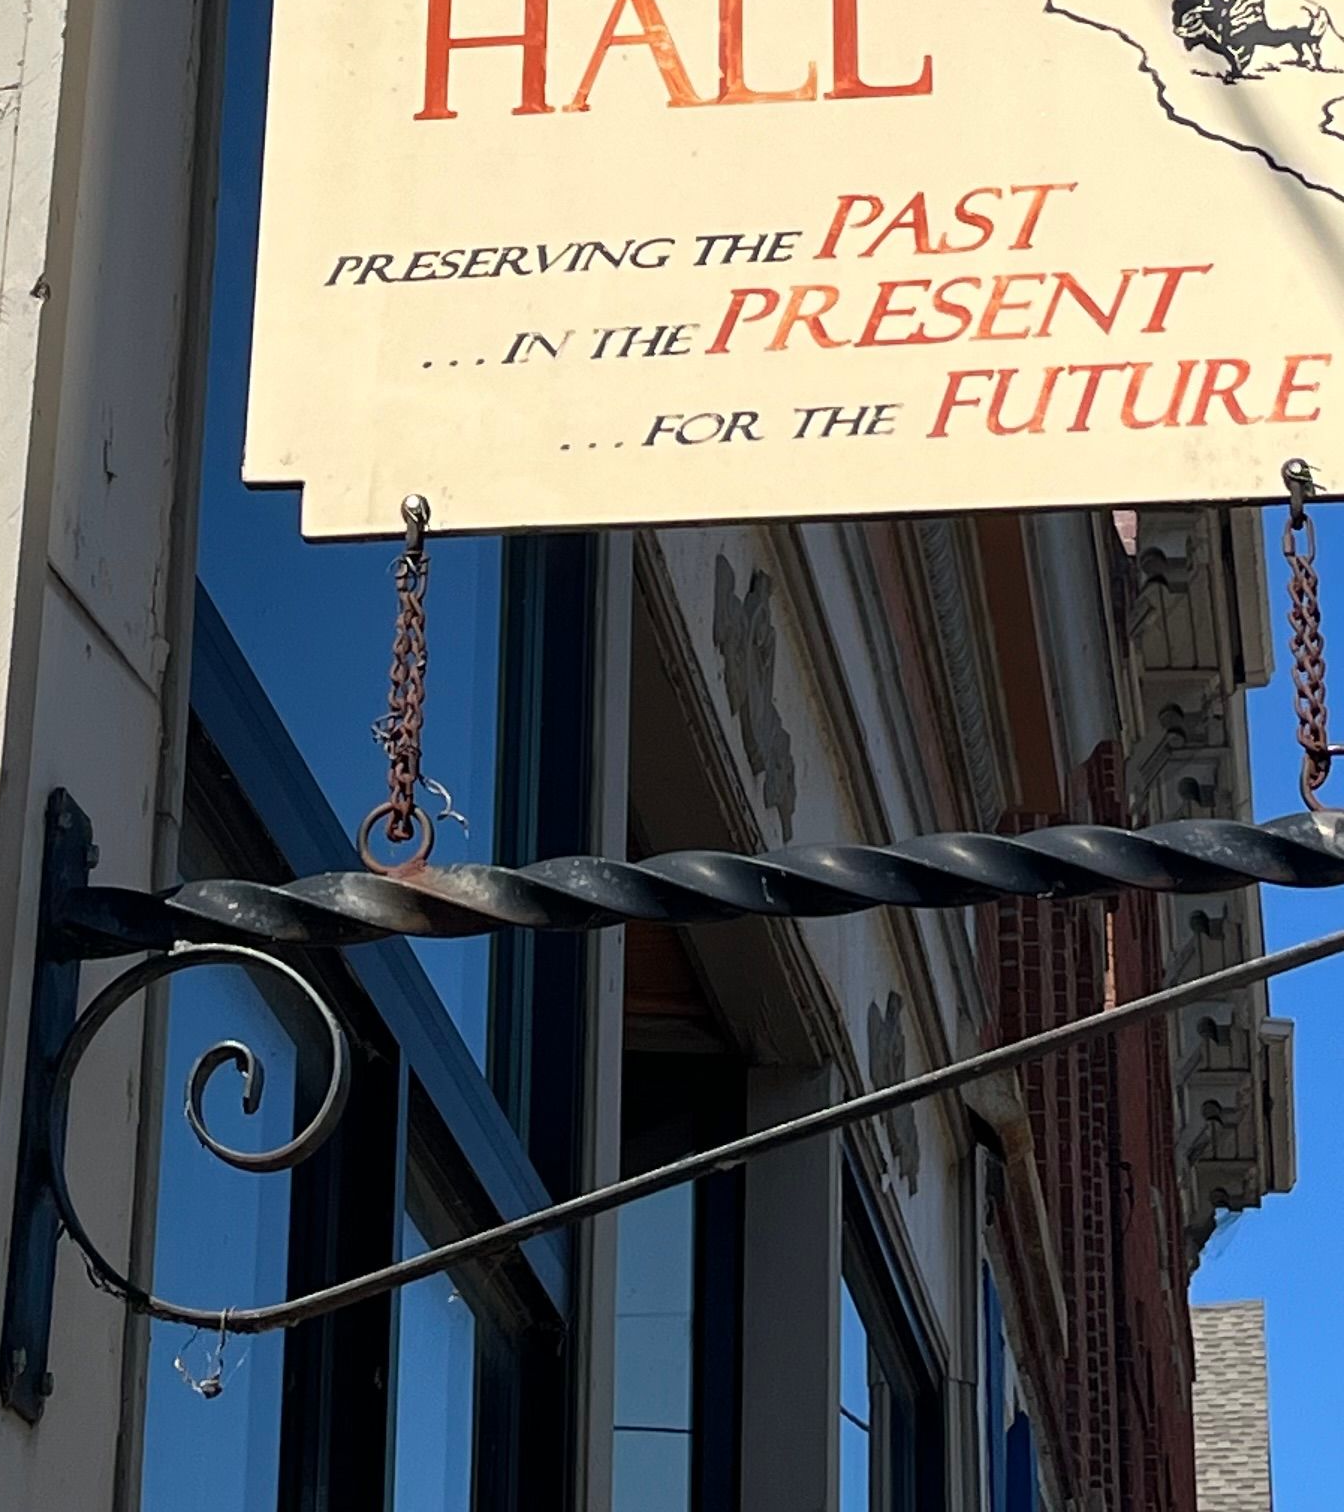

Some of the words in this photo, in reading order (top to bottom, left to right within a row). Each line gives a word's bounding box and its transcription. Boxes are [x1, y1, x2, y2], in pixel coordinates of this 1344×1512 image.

[323, 237, 676, 287] PRESERVING
[692, 230, 804, 267] THE
[812, 181, 1079, 261] PAST
[589, 322, 701, 360] THE
[703, 262, 1215, 356] PRESENT
[792, 401, 905, 439] THE
[925, 352, 1333, 439] FUTURE
